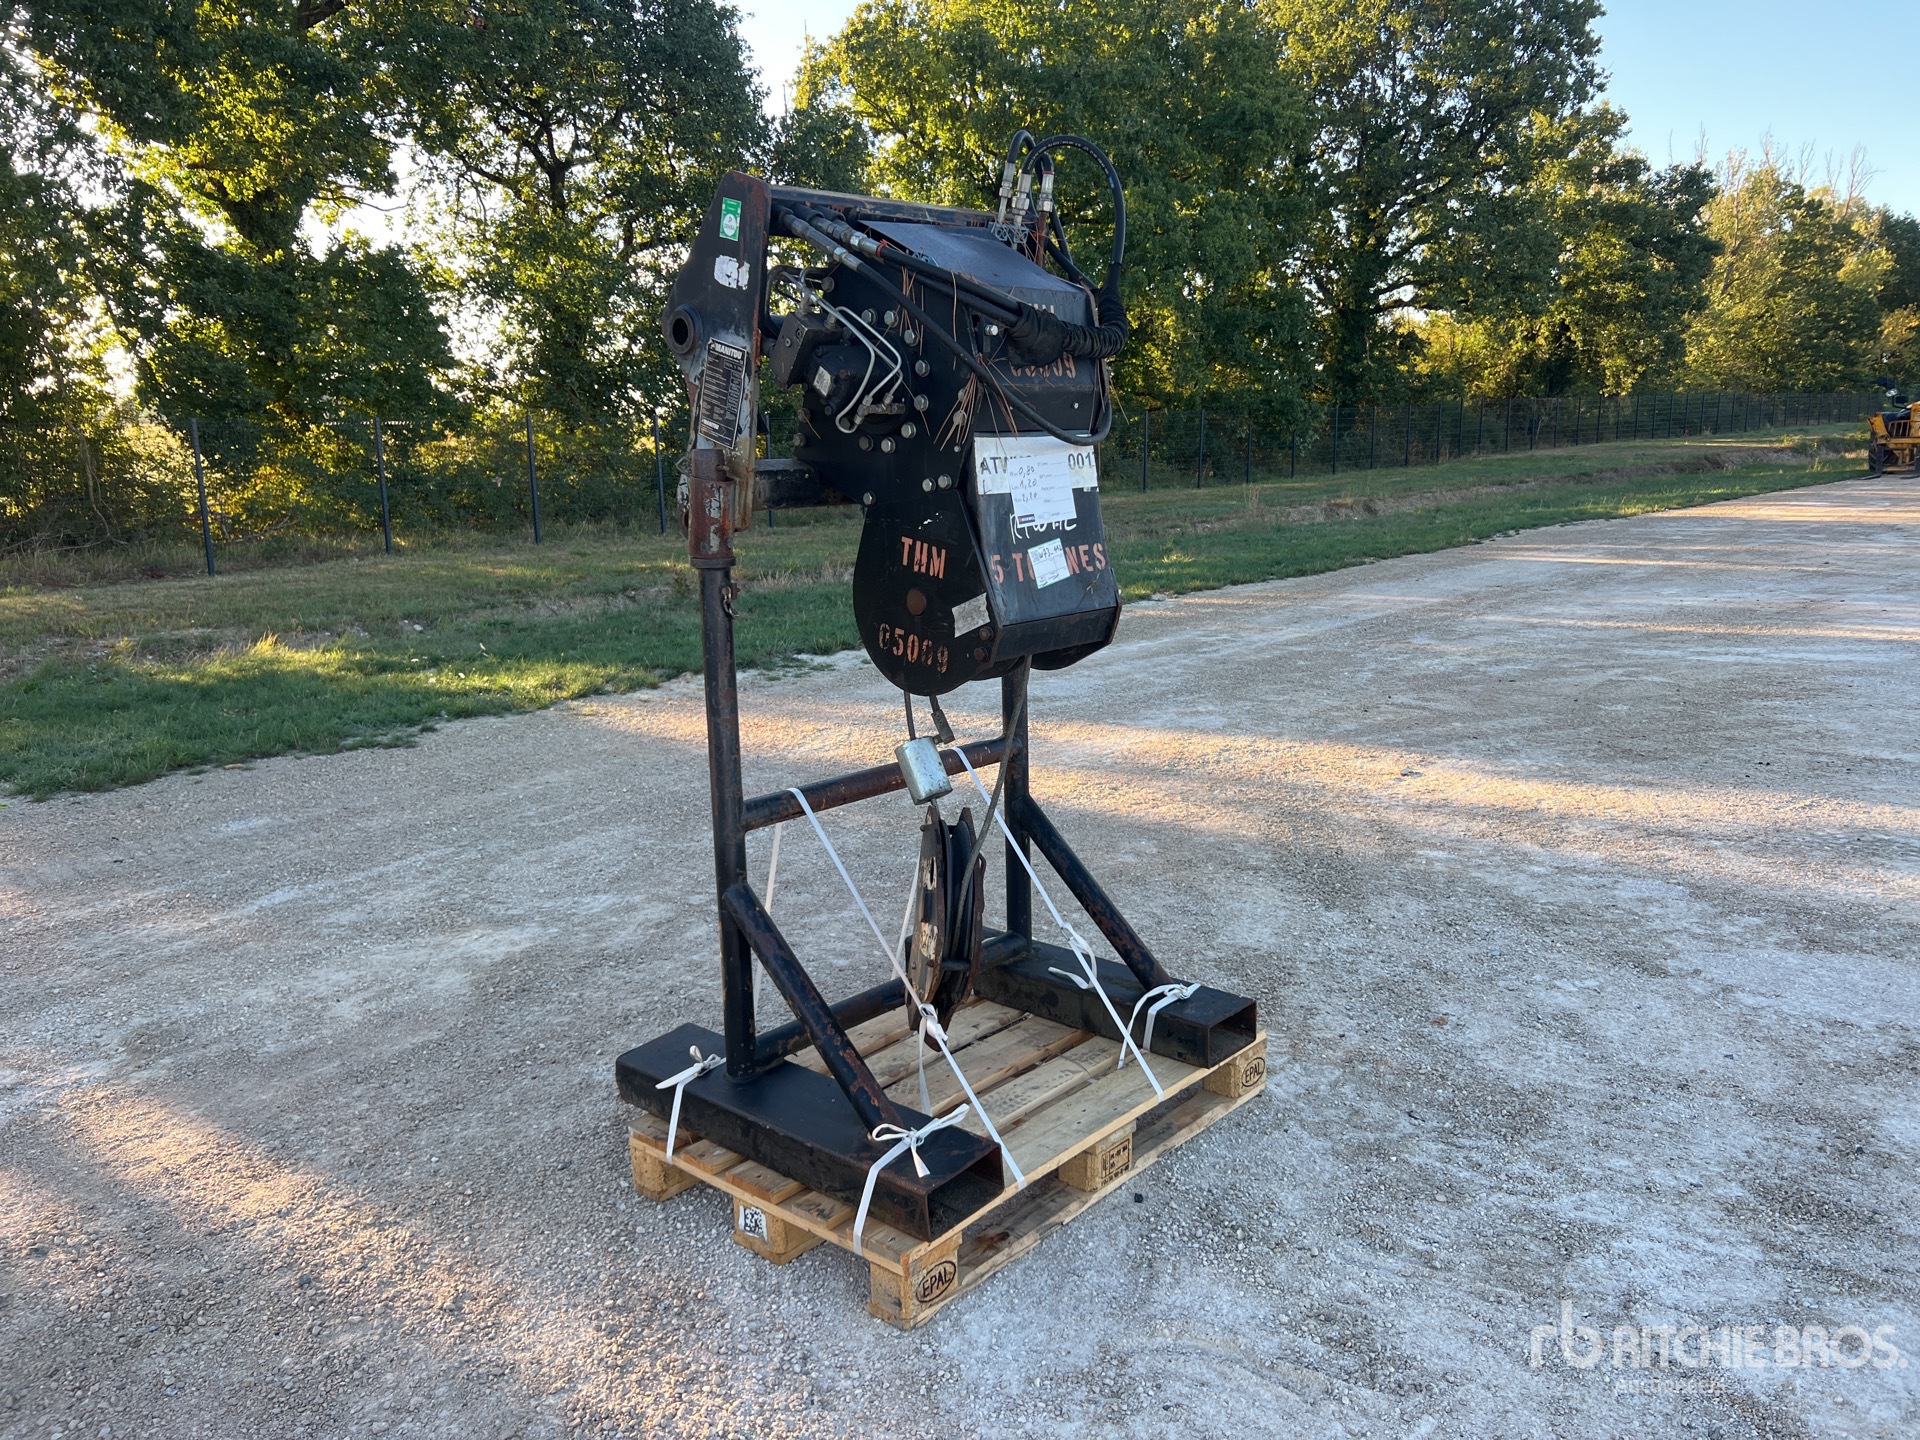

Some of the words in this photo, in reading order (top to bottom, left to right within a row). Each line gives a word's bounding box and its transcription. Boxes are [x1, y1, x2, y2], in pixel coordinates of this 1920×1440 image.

[714, 342, 743, 360] MANITOU
[1067, 451, 1095, 470] 001
[990, 554, 1004, 584] 5
[1012, 542, 1106, 582] TNES
[1244, 1061, 1263, 1084] EPAL
[922, 1266, 952, 1299] EPAL
